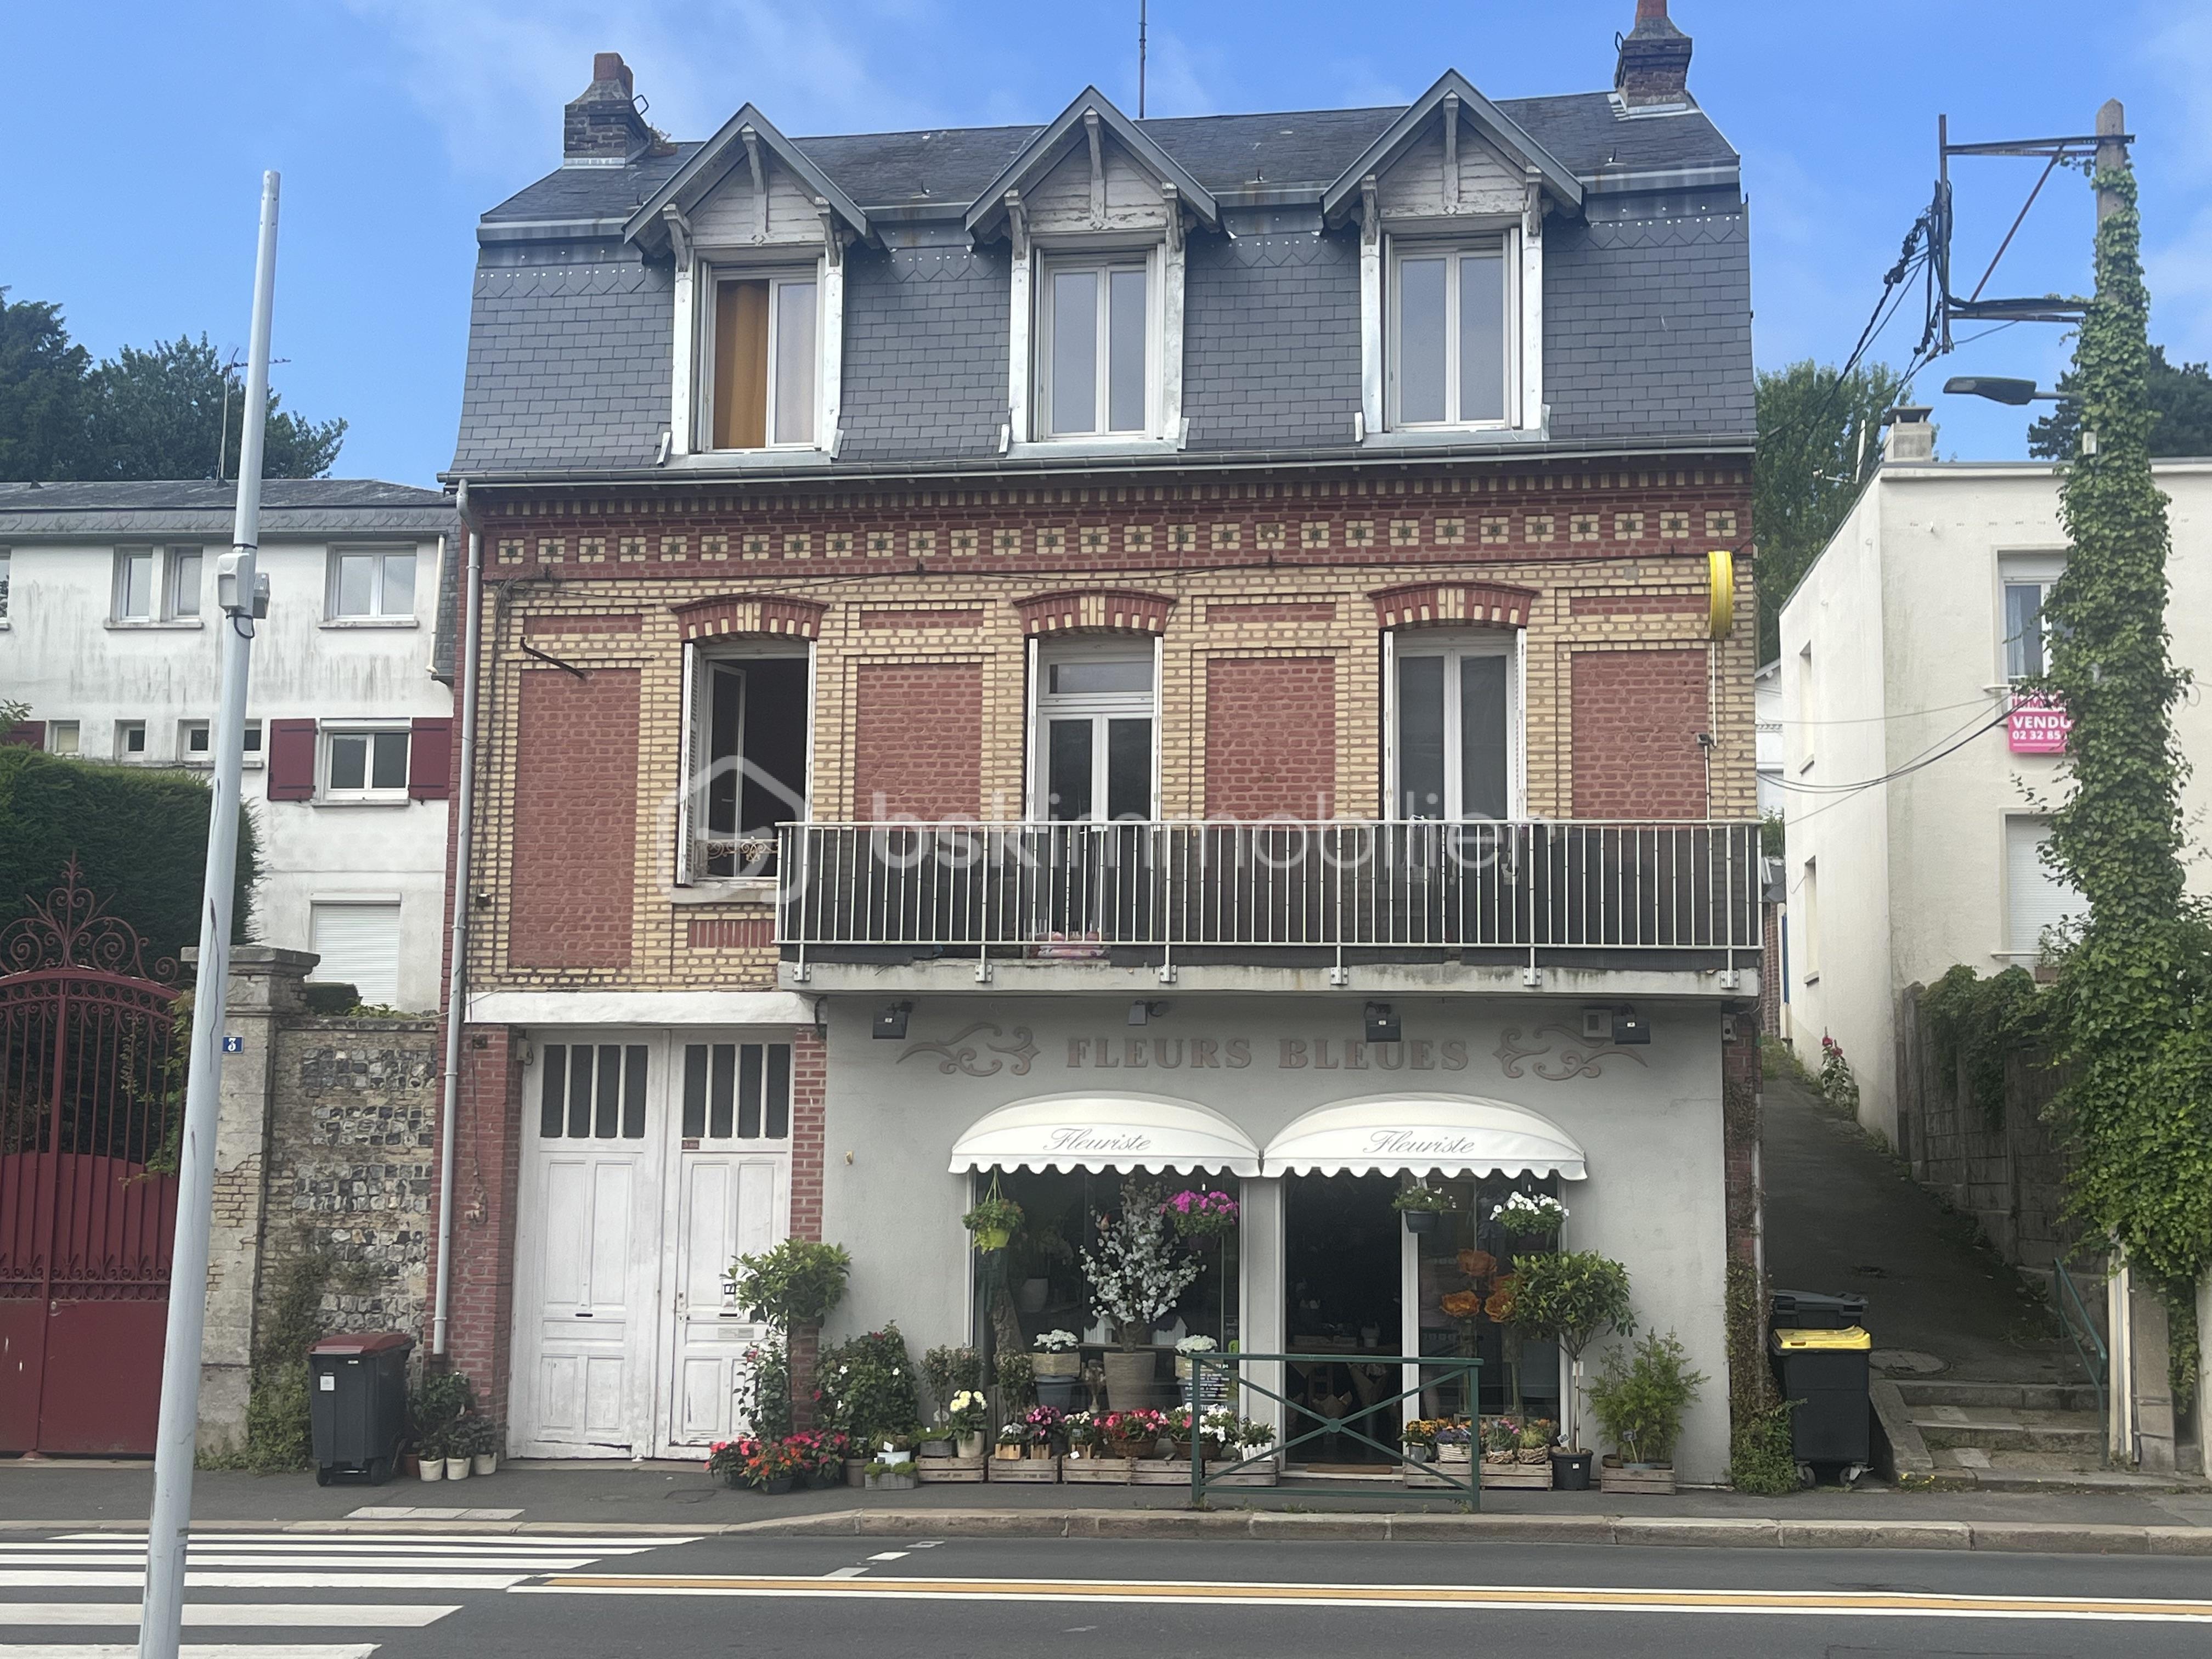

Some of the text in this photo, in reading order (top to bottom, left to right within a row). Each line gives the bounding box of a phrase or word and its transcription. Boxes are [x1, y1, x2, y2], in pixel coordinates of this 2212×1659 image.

[2012, 716, 2071, 729] VENDU
[2012, 730, 2027, 740] 02
[2030, 730, 2044, 740] 32
[2047, 730, 2061, 740] 85
[228, 1037, 236, 1052] 3
[1066, 1038, 1469, 1071] FLEURS BLEUES
[1043, 1127, 1152, 1152] Fleuriste
[1363, 1130, 1475, 1154] Fleuriste
